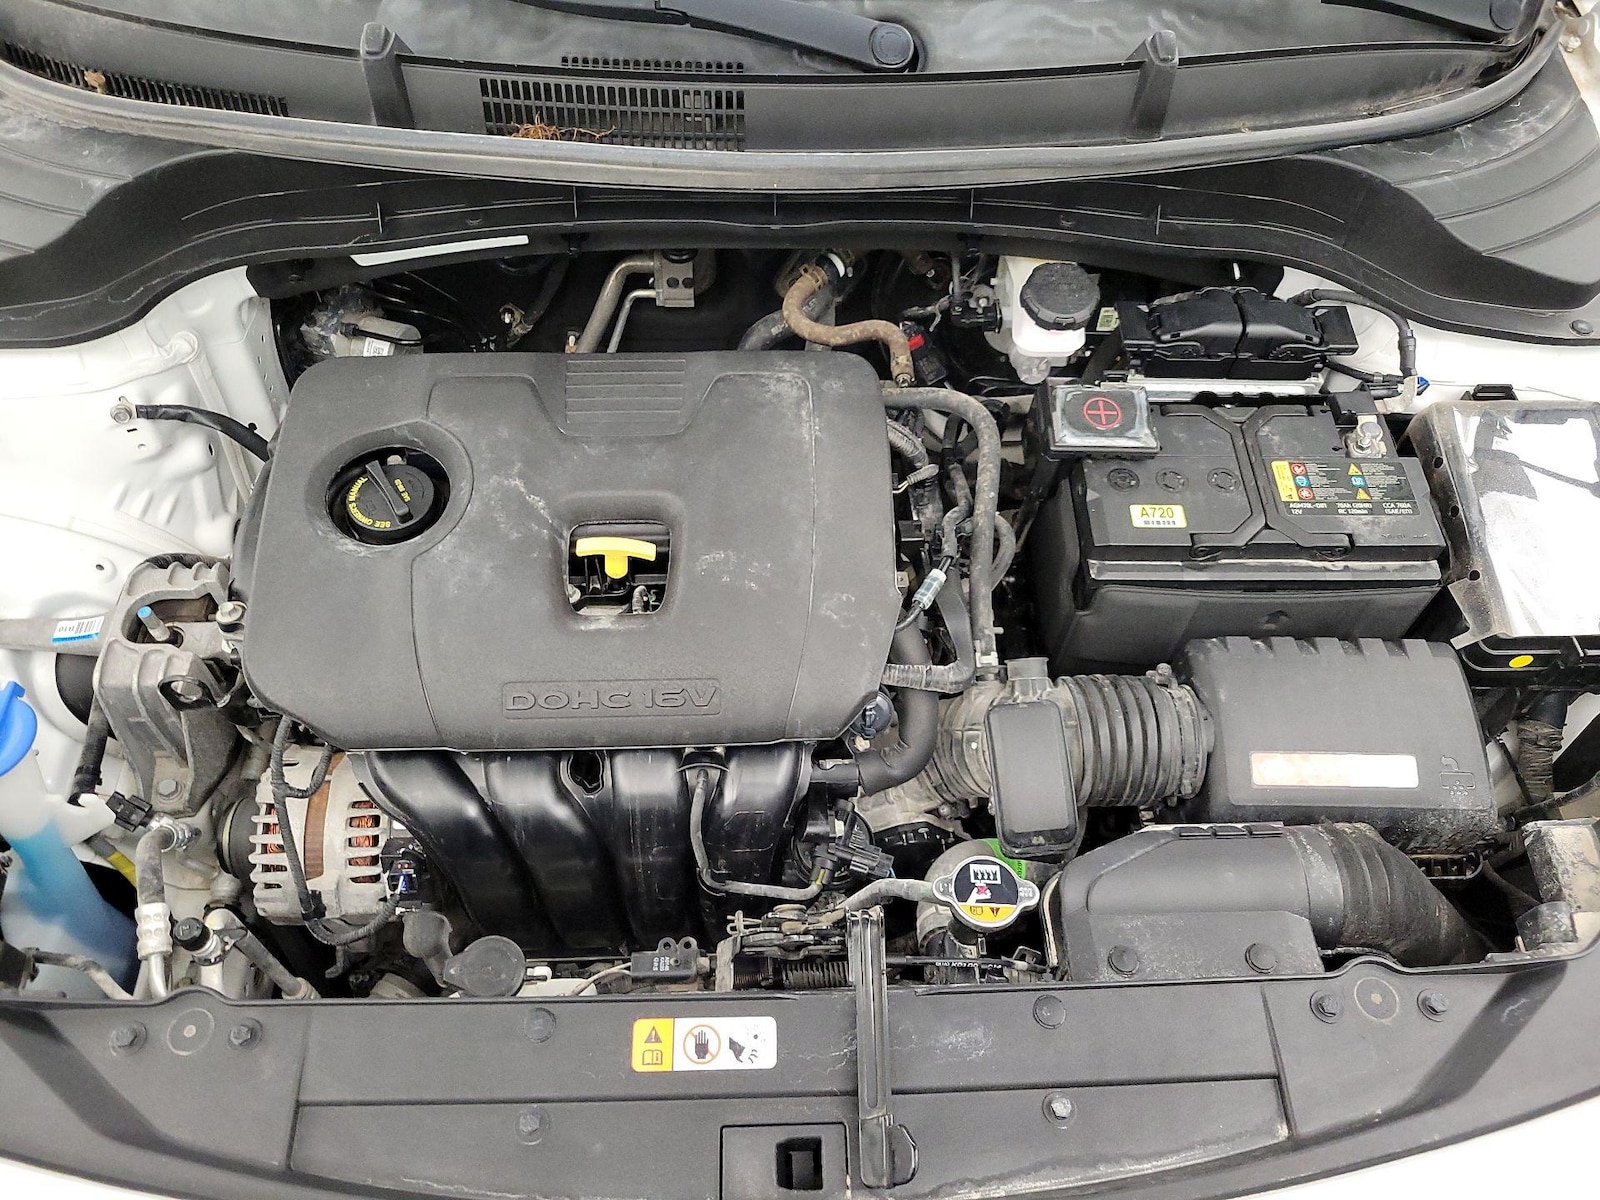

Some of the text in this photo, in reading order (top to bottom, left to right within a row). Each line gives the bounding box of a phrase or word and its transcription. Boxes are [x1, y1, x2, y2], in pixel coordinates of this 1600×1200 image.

[348, 476, 368, 502] MANUAL
[1141, 507, 1174, 518] A720
[505, 687, 718, 711] DOHC 16V
